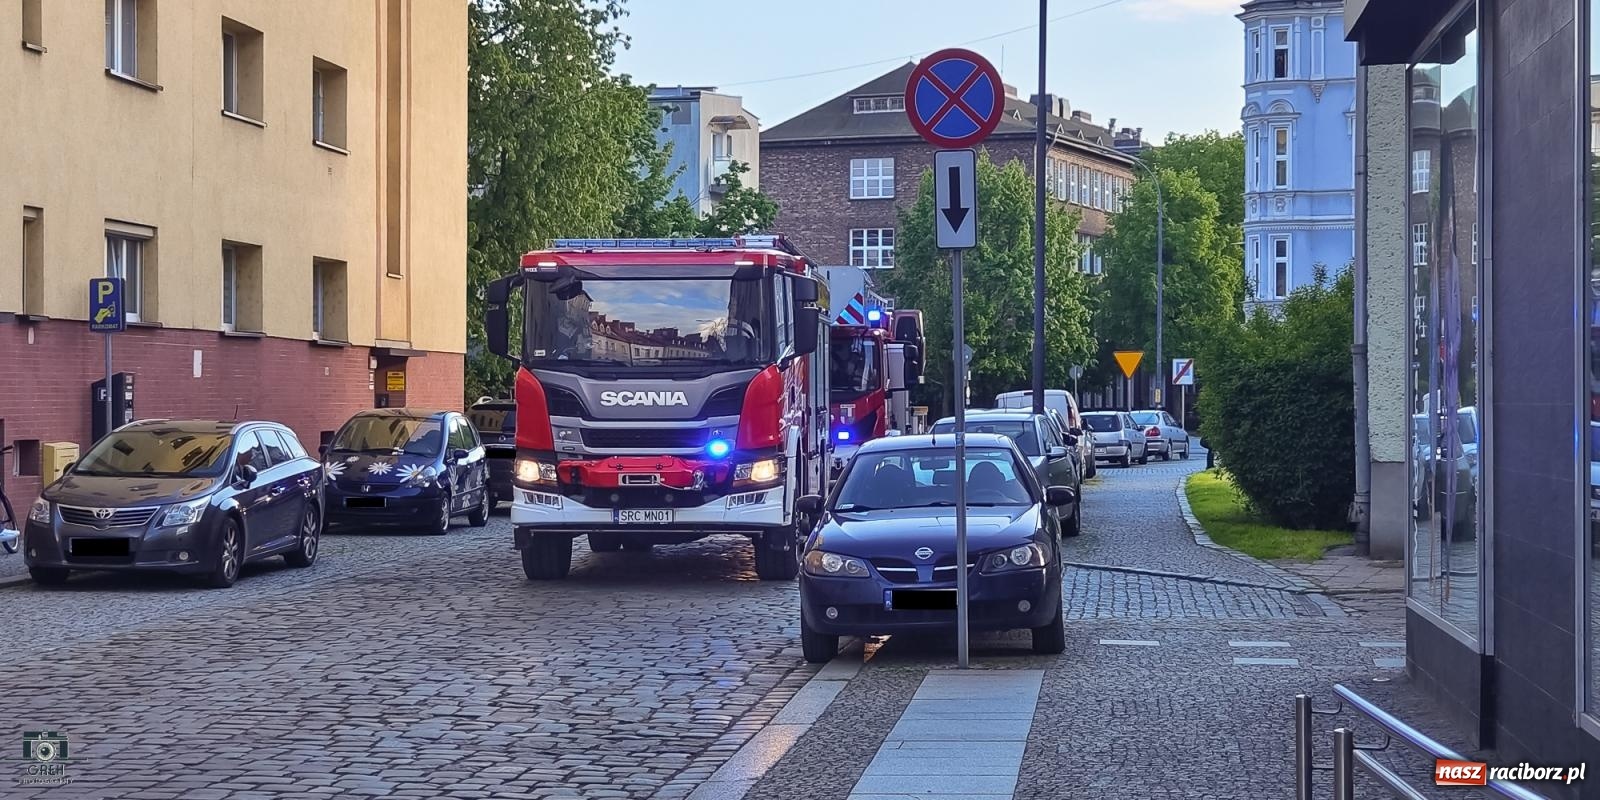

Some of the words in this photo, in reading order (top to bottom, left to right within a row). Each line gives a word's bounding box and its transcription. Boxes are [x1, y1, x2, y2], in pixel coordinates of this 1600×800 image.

[98, 281, 114, 304] P
[600, 391, 688, 406] SCANIA
[620, 510, 641, 521] SRC
